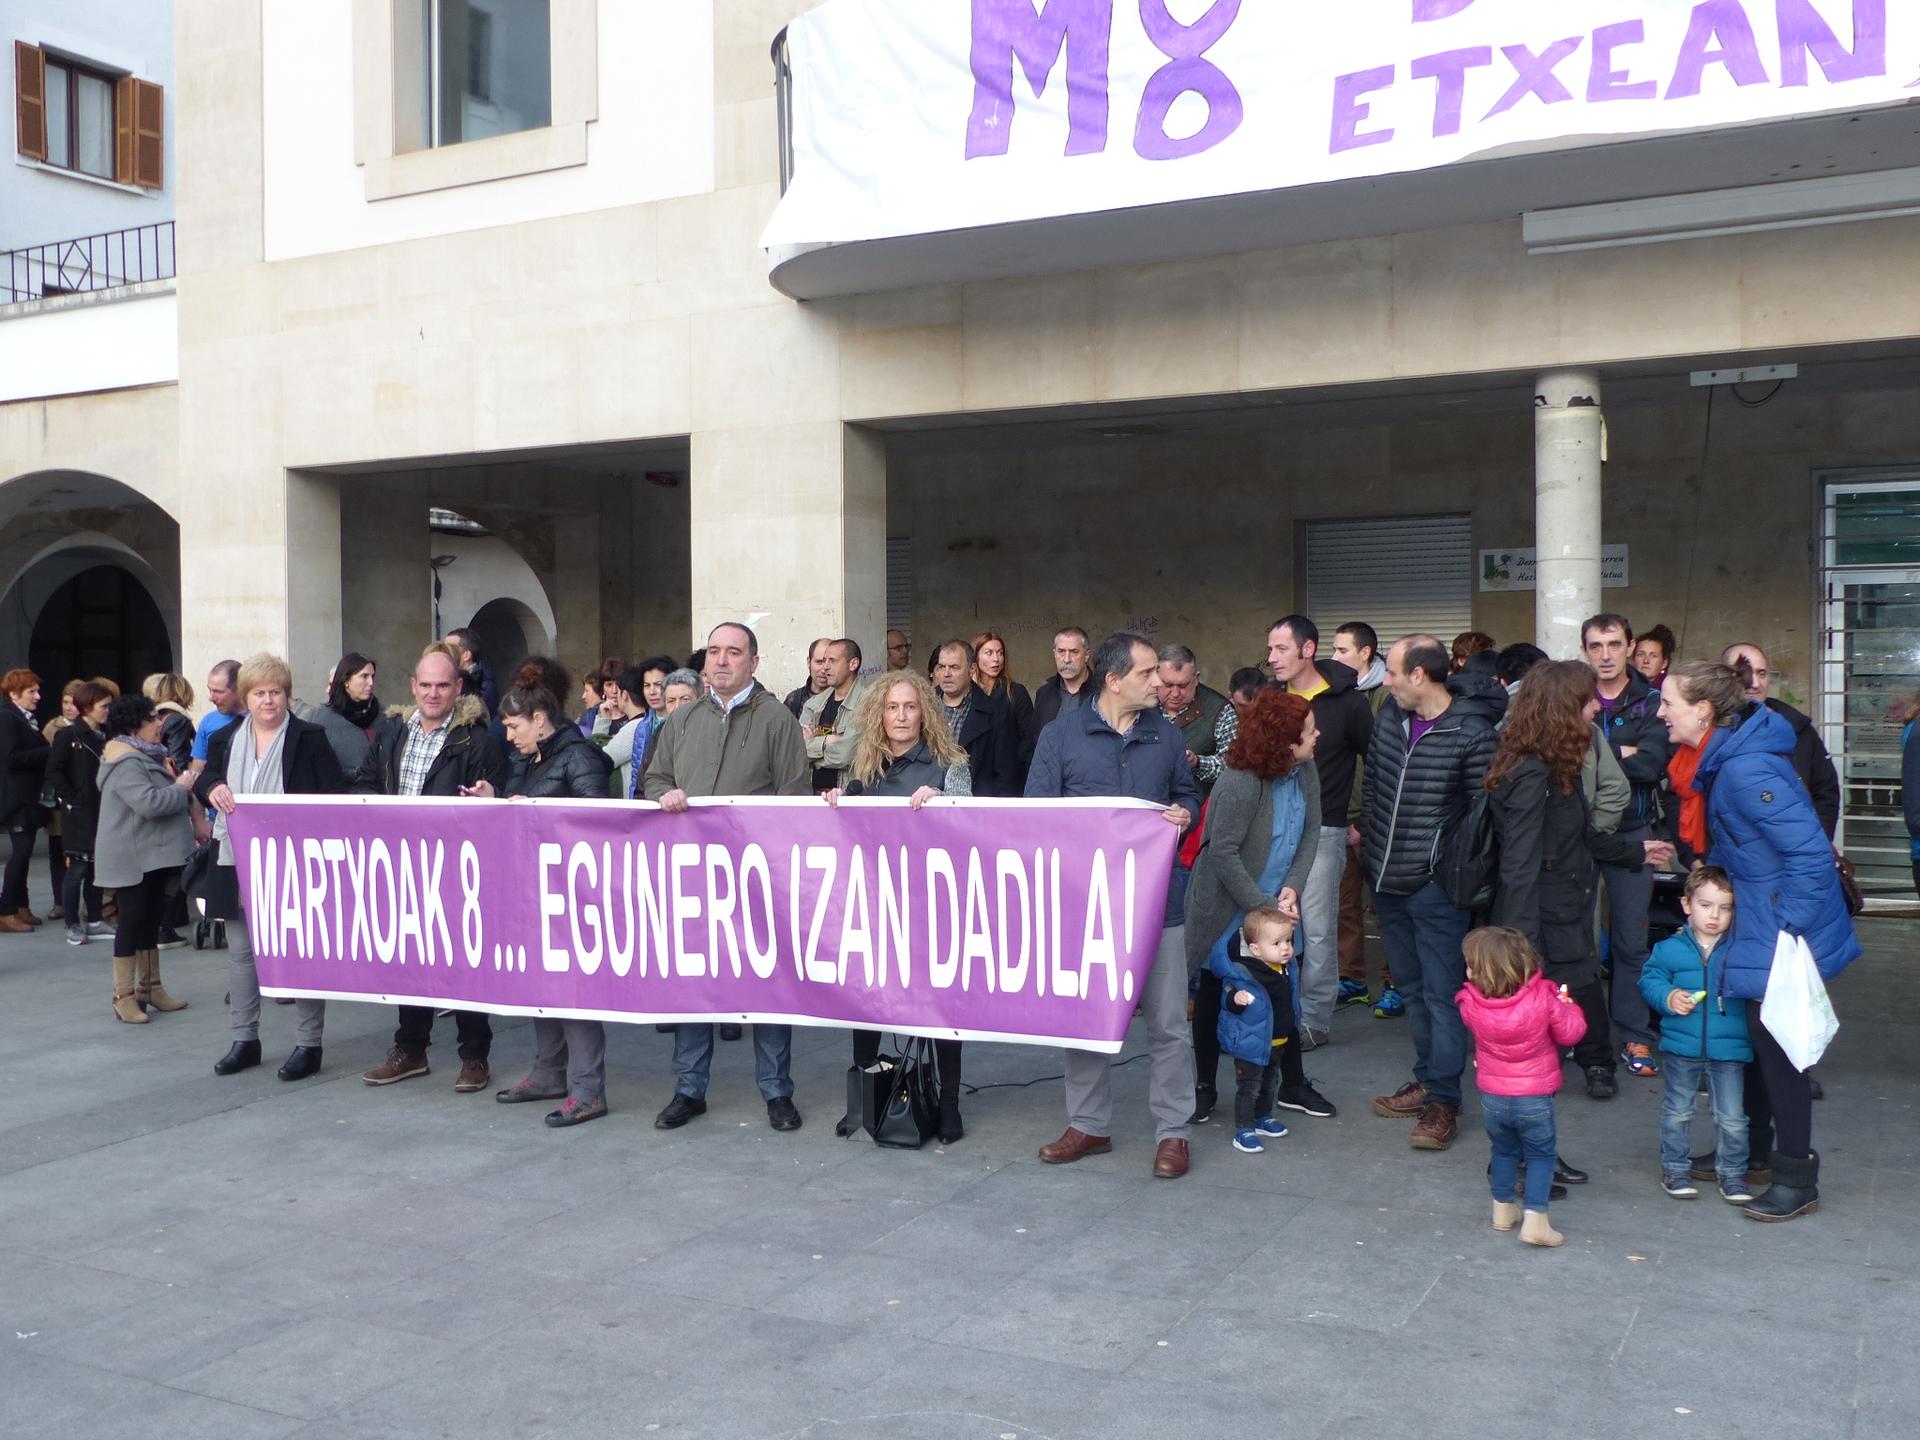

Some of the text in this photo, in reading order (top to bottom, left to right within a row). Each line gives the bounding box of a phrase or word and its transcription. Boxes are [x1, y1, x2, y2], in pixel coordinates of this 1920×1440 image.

[249, 836, 453, 968] MARTXOAK
[459, 839, 484, 968] 8
[538, 840, 777, 980] EGUNERO
[790, 843, 910, 989] IZAN
[926, 846, 1136, 1001] DADILA!
